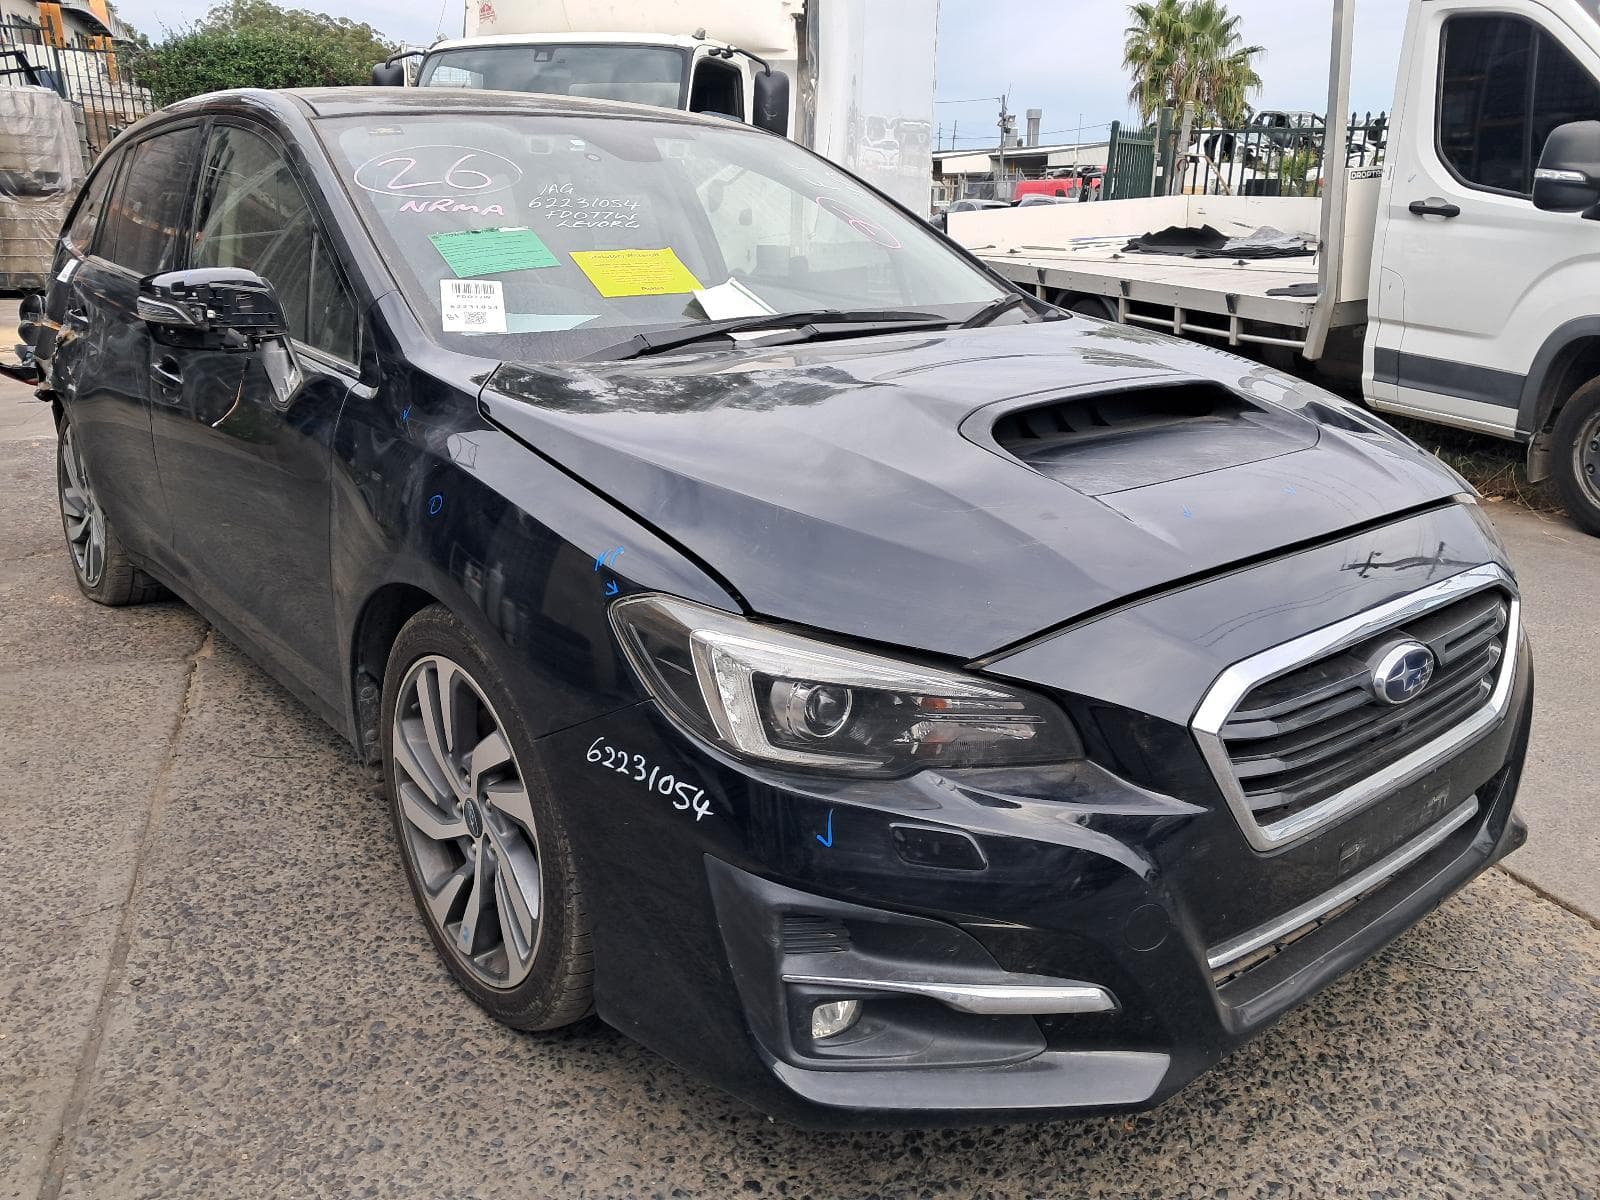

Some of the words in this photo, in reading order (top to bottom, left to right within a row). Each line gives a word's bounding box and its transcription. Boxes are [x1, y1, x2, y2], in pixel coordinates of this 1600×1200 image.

[377, 153, 493, 190] 26
[400, 198, 505, 216] NRMA
[528, 196, 641, 211] 62231054
[586, 736, 715, 822] 62231054
